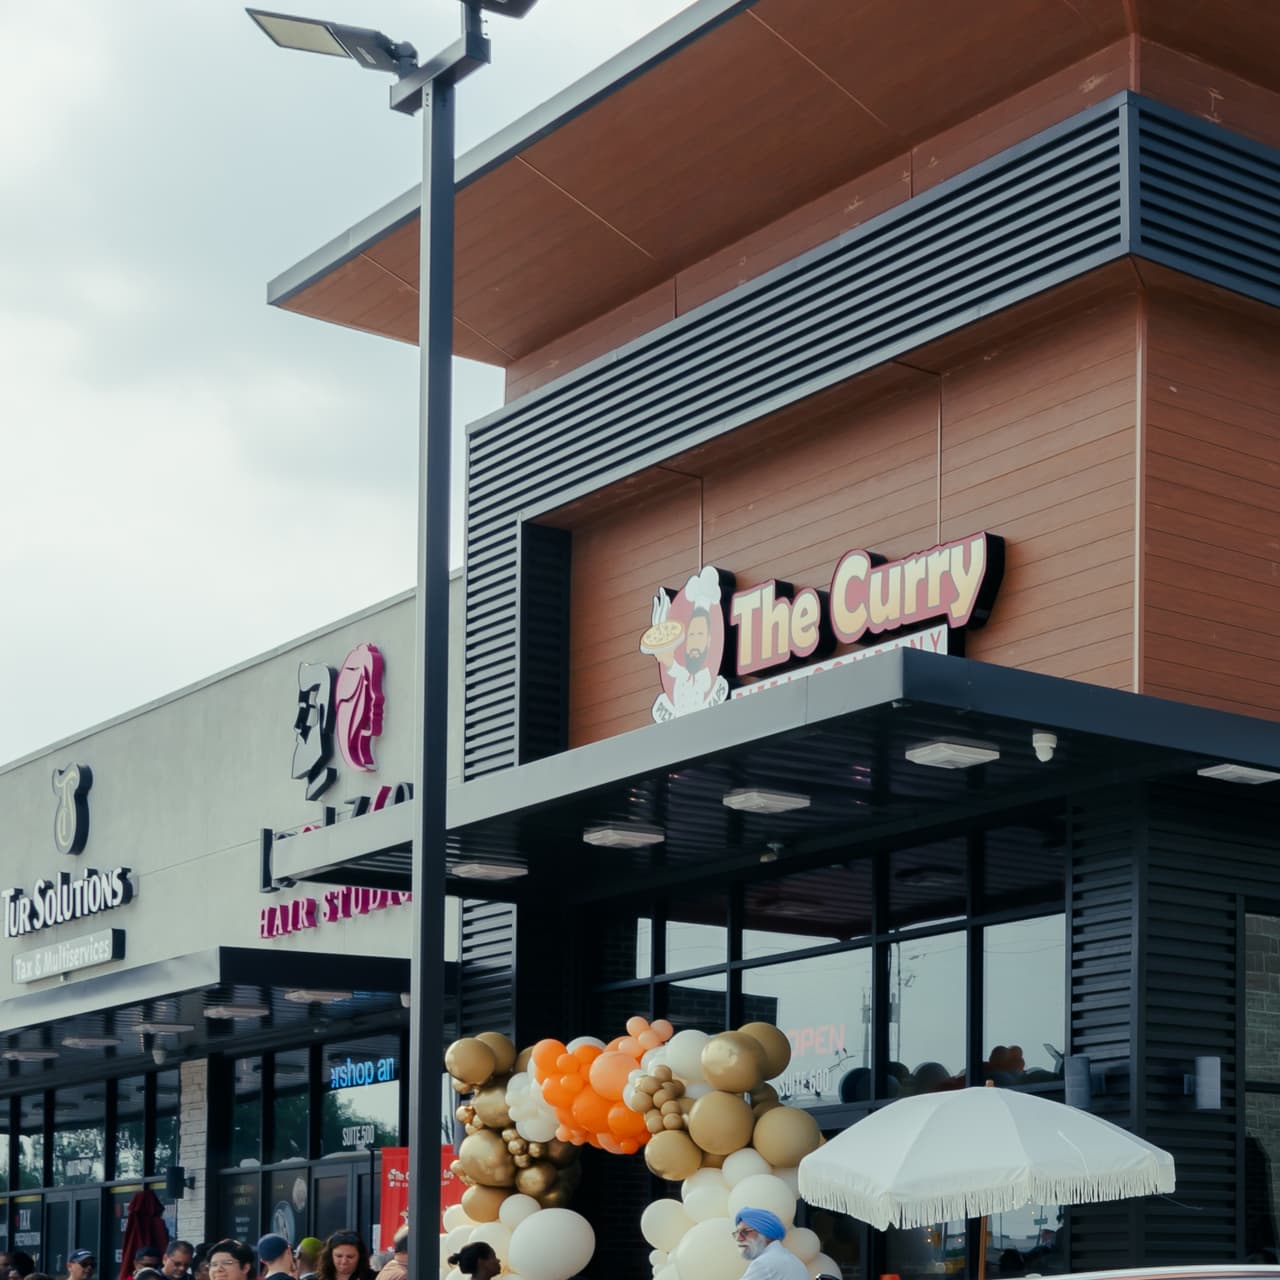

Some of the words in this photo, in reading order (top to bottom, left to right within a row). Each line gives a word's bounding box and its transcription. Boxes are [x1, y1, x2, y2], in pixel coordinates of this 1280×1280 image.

[731, 579, 822, 676] The
[829, 531, 990, 645] Curry
[260, 898, 318, 939] HAIR
